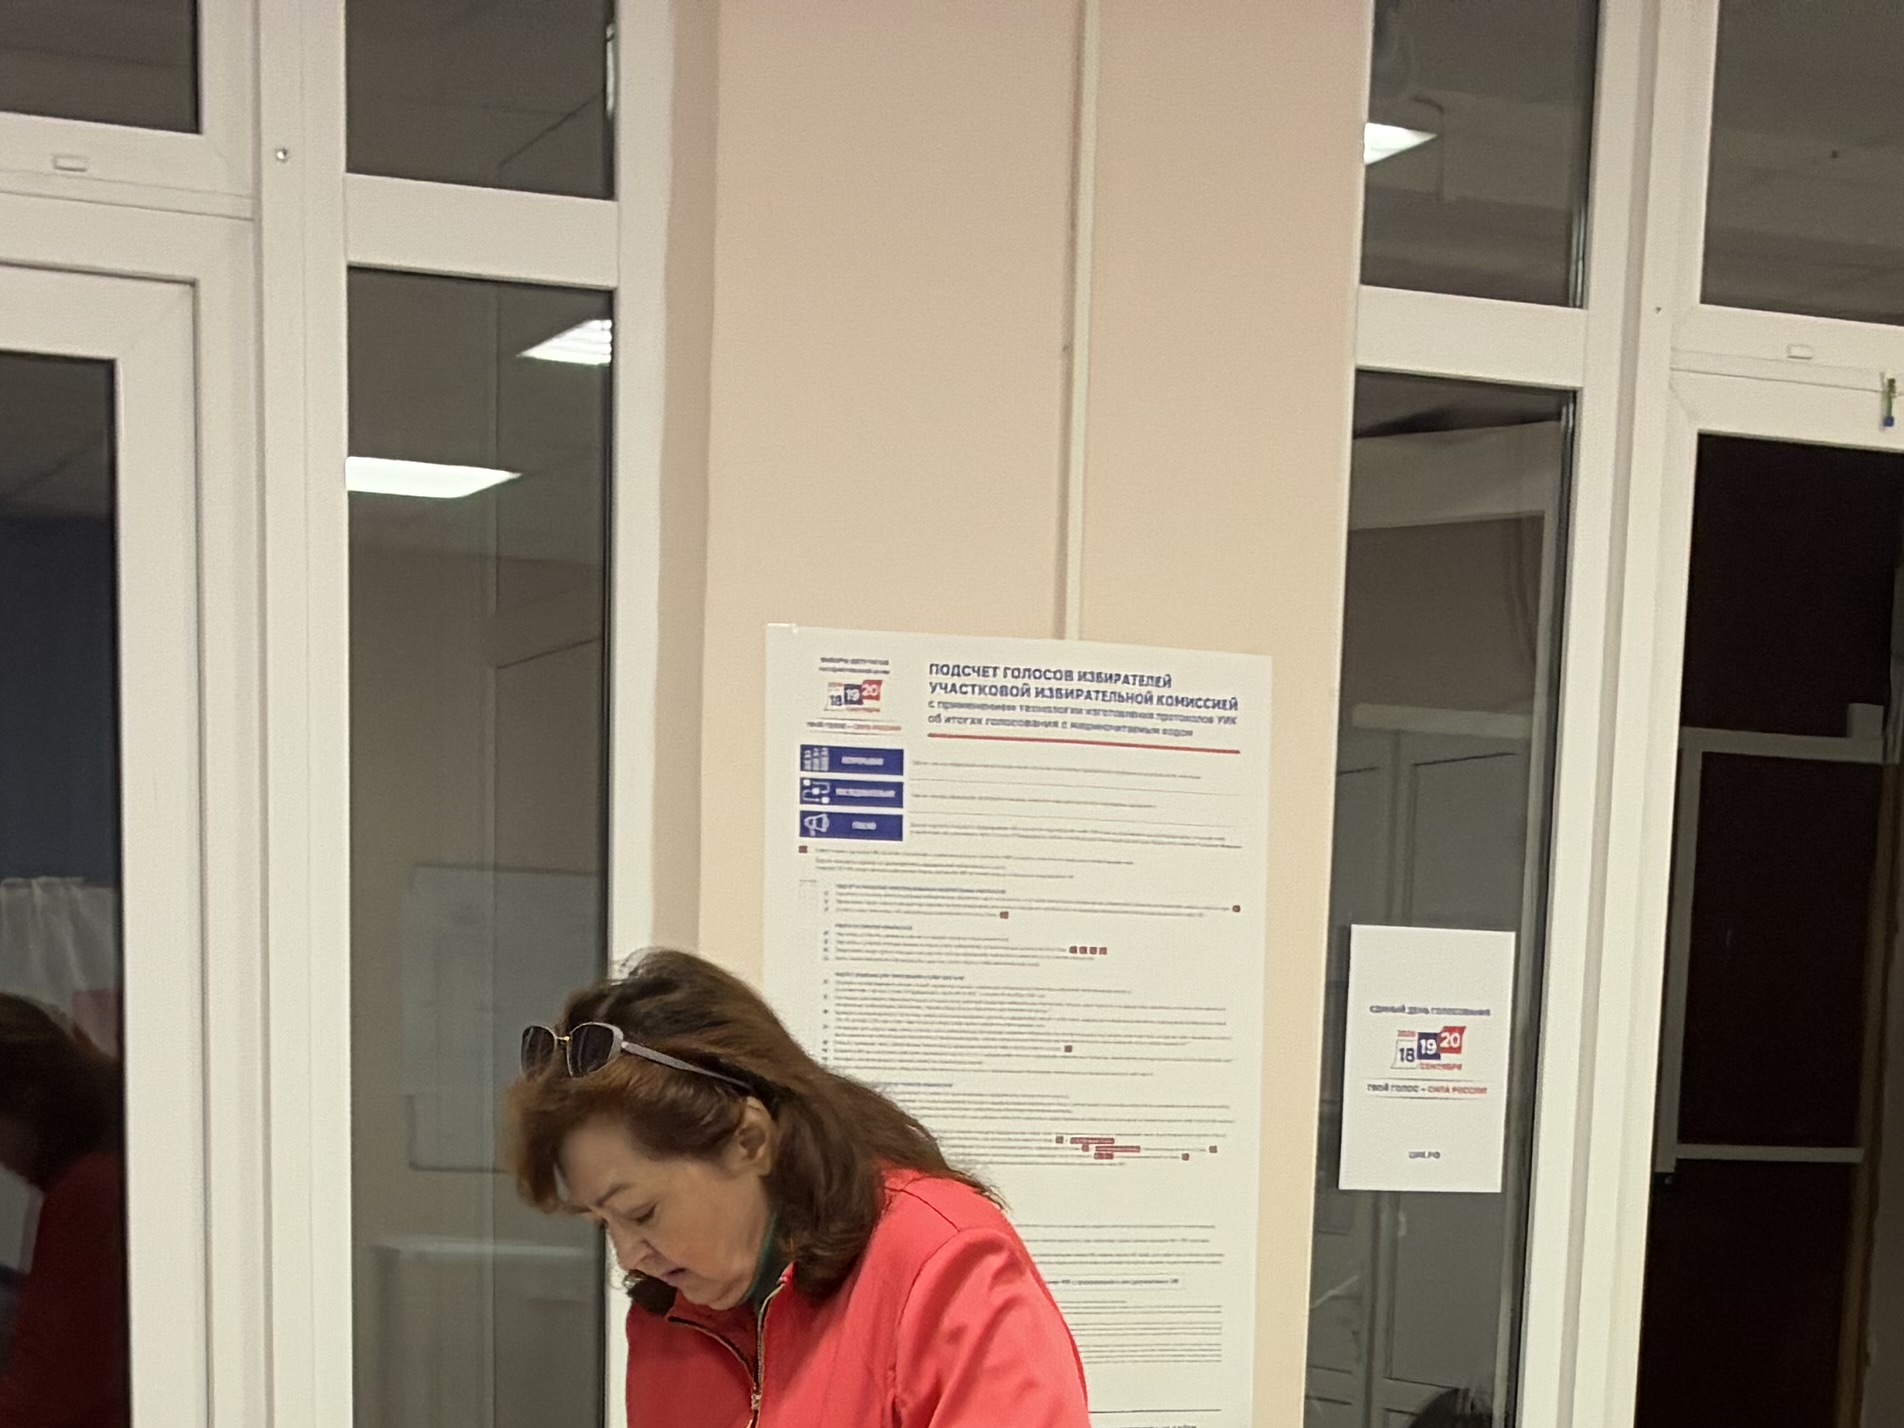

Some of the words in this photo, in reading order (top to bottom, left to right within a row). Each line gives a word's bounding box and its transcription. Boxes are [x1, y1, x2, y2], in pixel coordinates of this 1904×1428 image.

[928, 663, 1000, 678] ПОДСЧЕТ
[1002, 666, 1074, 682] ГОЛОСОВ
[1077, 670, 1172, 689] ИЗБИРАТЕЛЕЙ
[862, 683, 879, 697] 20
[928, 681, 1031, 698] УЧАСТКОВОЙ
[1034, 686, 1154, 706] ИЗБИРАТЕЛЬНОЙ
[1156, 695, 1239, 712] КОМИССИЕЙ
[1419, 1038, 1437, 1054] 19
[1439, 1032, 1461, 1048] 20
[1399, 1047, 1415, 1063] 18
